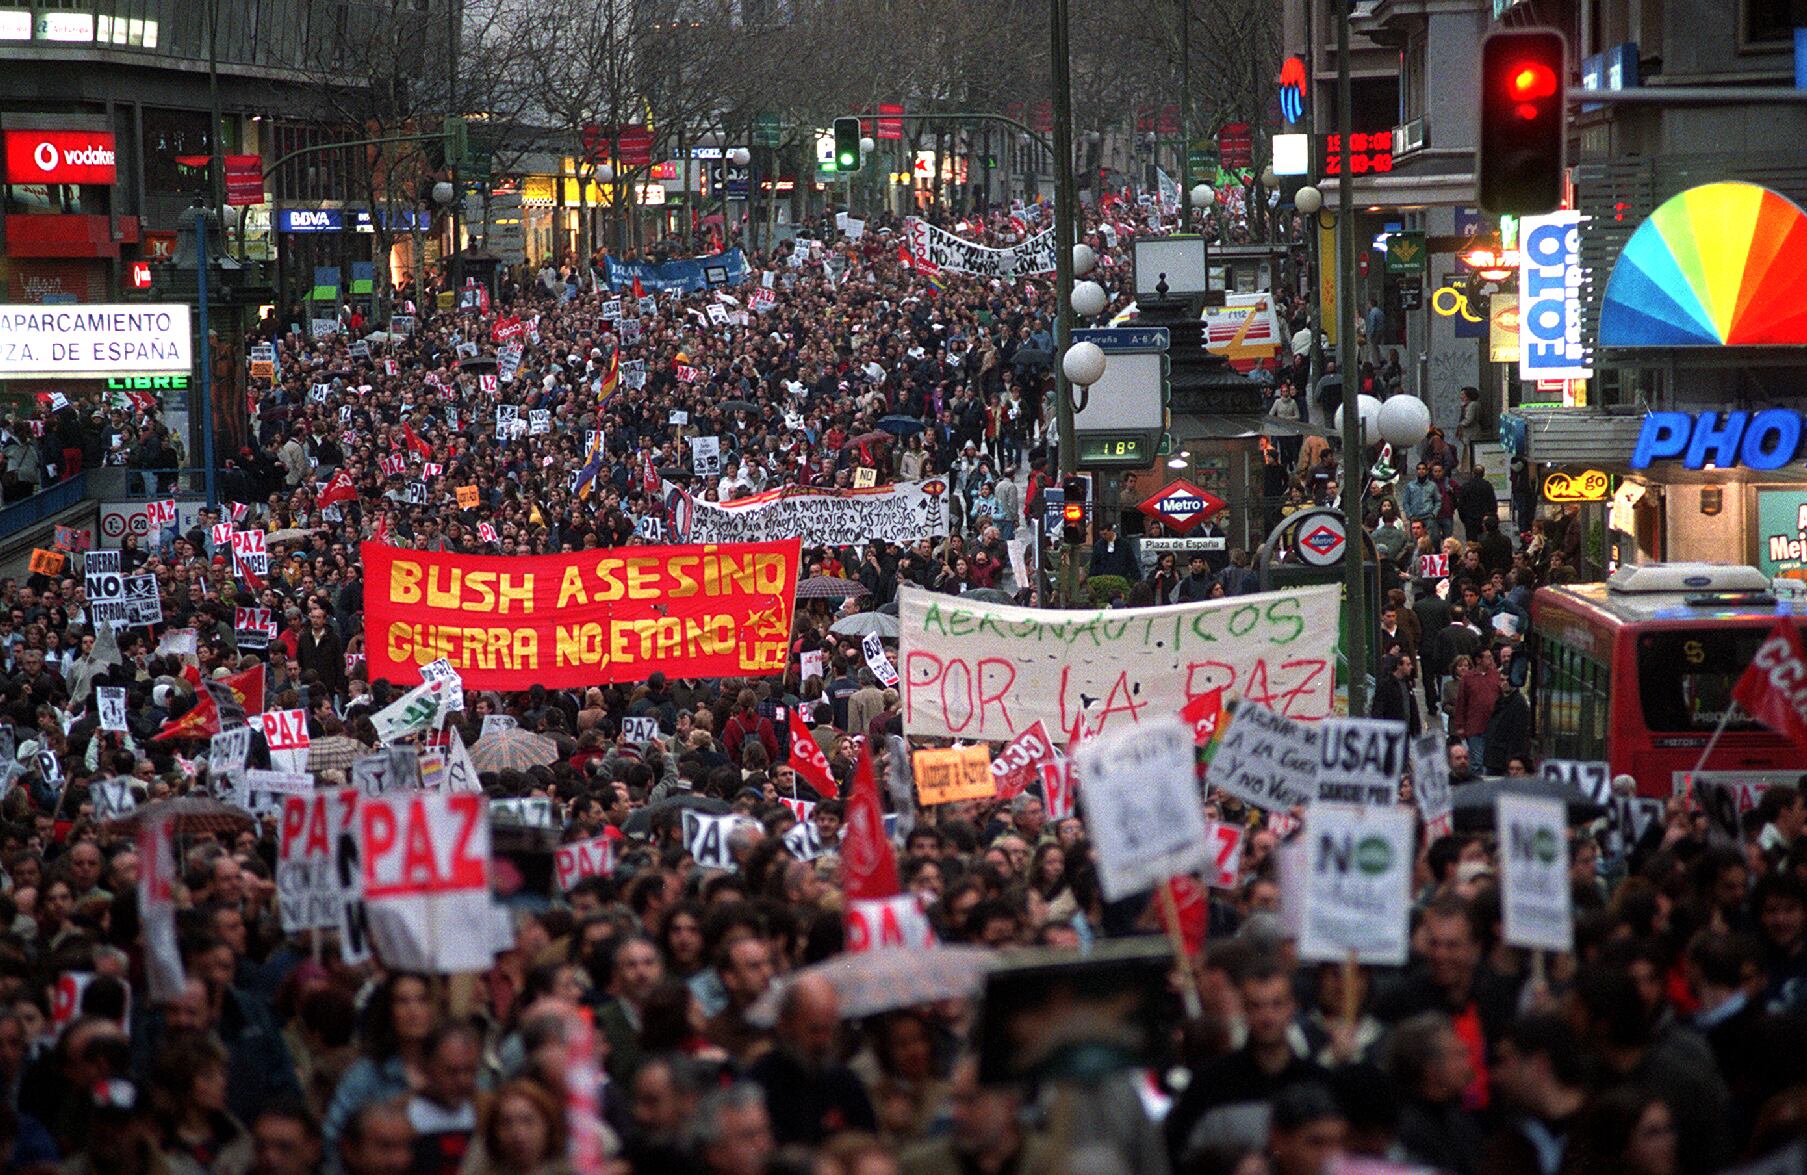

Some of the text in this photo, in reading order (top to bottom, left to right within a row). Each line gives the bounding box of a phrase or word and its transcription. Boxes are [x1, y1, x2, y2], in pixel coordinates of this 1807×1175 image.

[290, 211, 330, 226] BBVA
[1527, 223, 1566, 369] FOTO
[1, 313, 171, 332] APARCAMIENTO
[0, 338, 180, 361] ZA. DE ESPAÑA
[1084, 334, 1118, 344] Coruña
[108, 376, 188, 389] LIBRE
[1630, 409, 1807, 471] PHO
[381, 454, 405, 476] PAZ
[147, 500, 175, 524] PAZ
[1163, 497, 1201, 512] Metro
[133, 519, 147, 530] 20
[232, 530, 265, 554] PAZ
[1145, 540, 1220, 551] Plaza de España
[1311, 535, 1335, 546] Metro
[86, 552, 120, 575] GUERRA
[1421, 554, 1449, 577] PAZ
[86, 575, 120, 598] NO
[389, 559, 535, 614] BUSH
[235, 607, 271, 631] PAZ
[387, 621, 538, 670] GUERRA
[906, 650, 1015, 734] POR
[1060, 664, 1149, 735] LA
[263, 710, 310, 747] PAZ
[623, 718, 656, 743] PAZ
[360, 795, 487, 891] PAZ
[555, 838, 614, 890] PAZ
